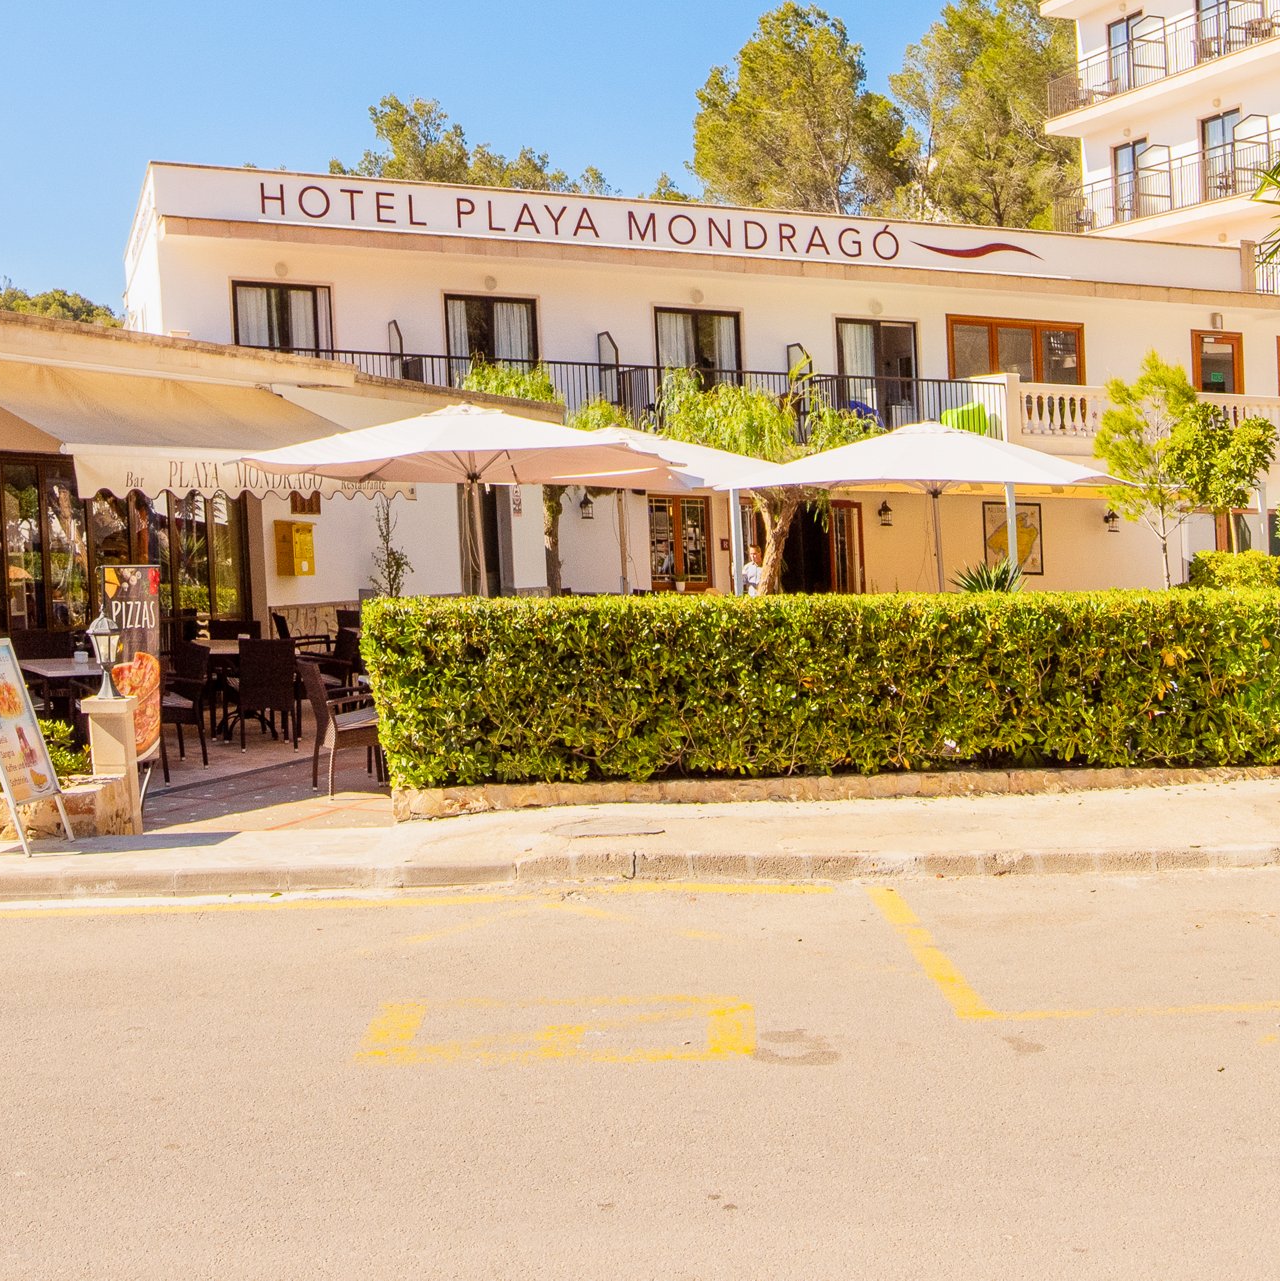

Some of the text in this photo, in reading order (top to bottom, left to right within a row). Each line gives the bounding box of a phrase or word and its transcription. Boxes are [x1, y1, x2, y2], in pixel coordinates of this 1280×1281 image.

[260, 182, 900, 261] HOTEL PLAYA MONDRAGÓ
[125, 471, 144, 488] Bar
[169, 460, 220, 489] PLAYA
[111, 600, 156, 629] PIZZAS
